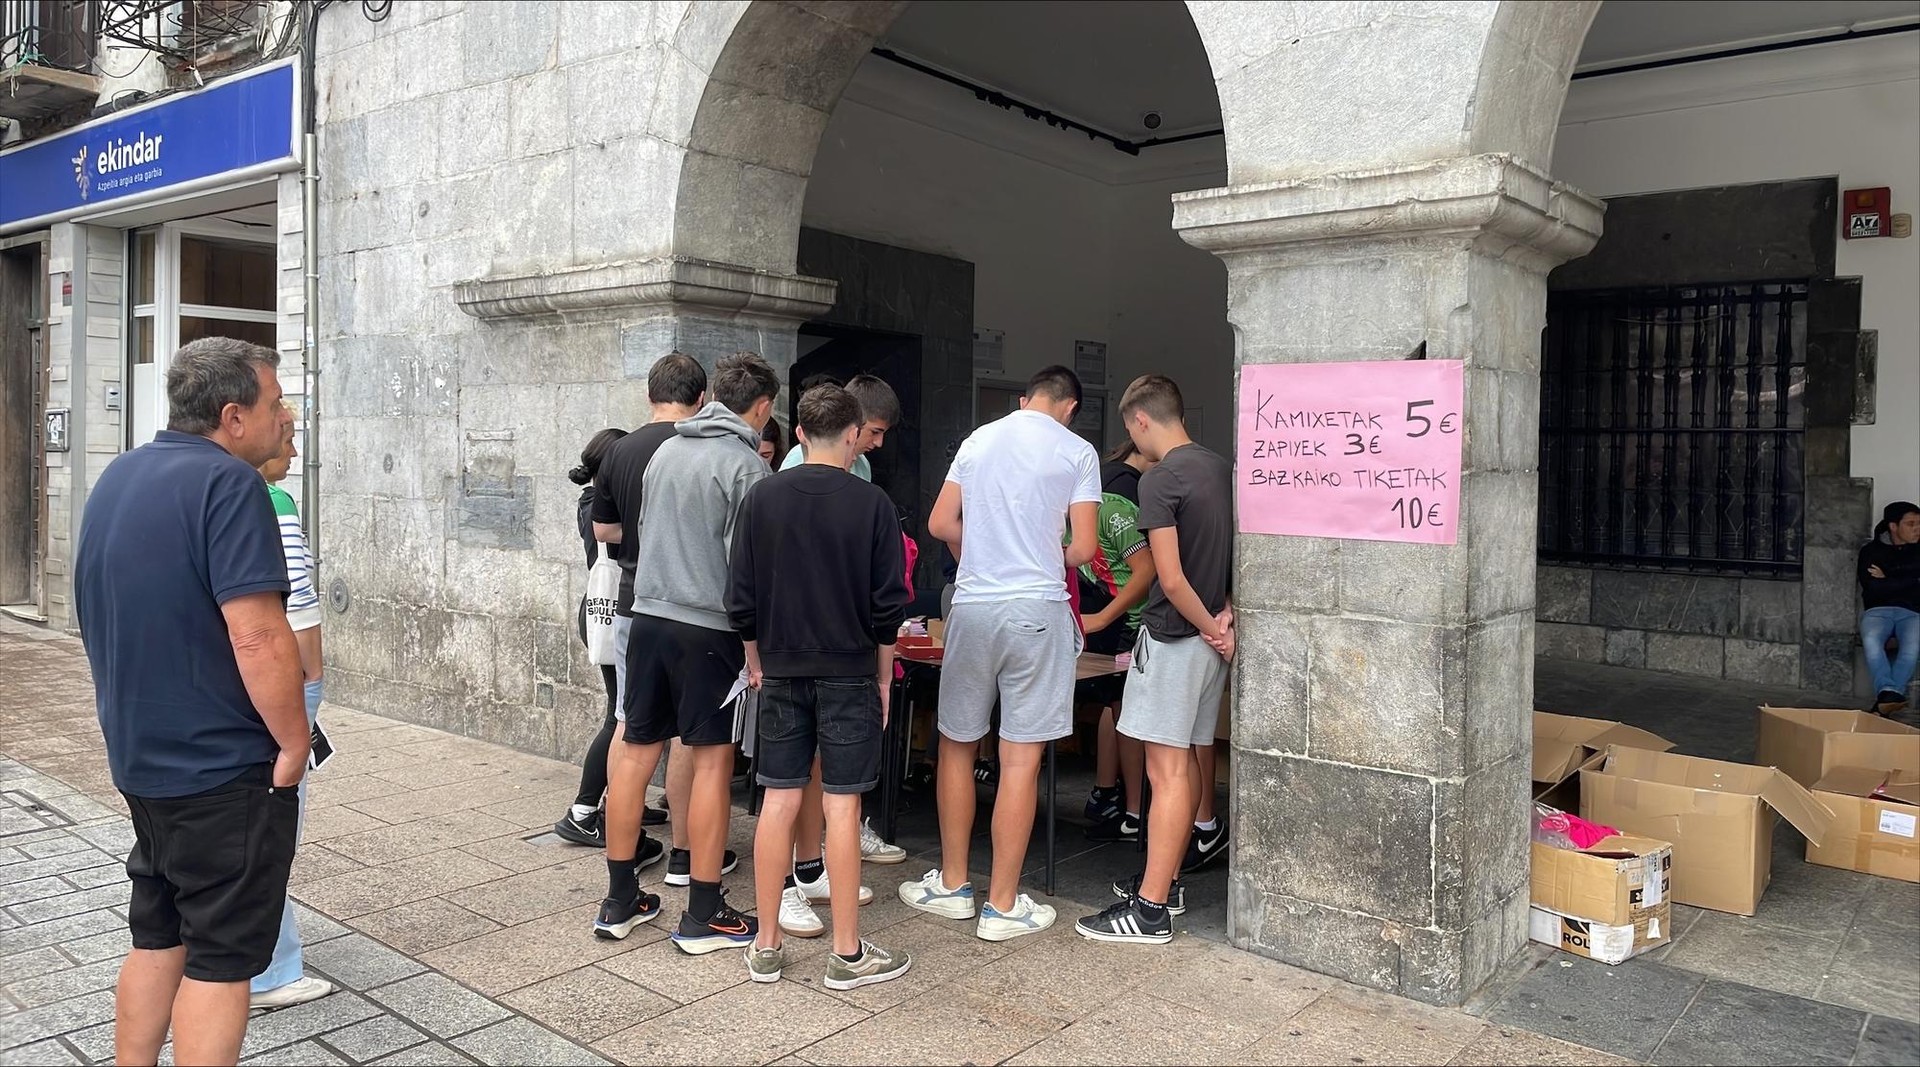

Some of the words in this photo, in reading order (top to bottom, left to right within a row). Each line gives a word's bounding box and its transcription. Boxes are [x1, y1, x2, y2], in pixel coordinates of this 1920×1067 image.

[97, 131, 162, 174] ekindar
[134, 171, 144, 183] eta
[1255, 389, 1383, 430] KAMIXETAK
[1252, 440, 1327, 458] ZAPIYEK
[1353, 468, 1447, 491] TIKETAK
[1562, 933, 1590, 949] ROL
